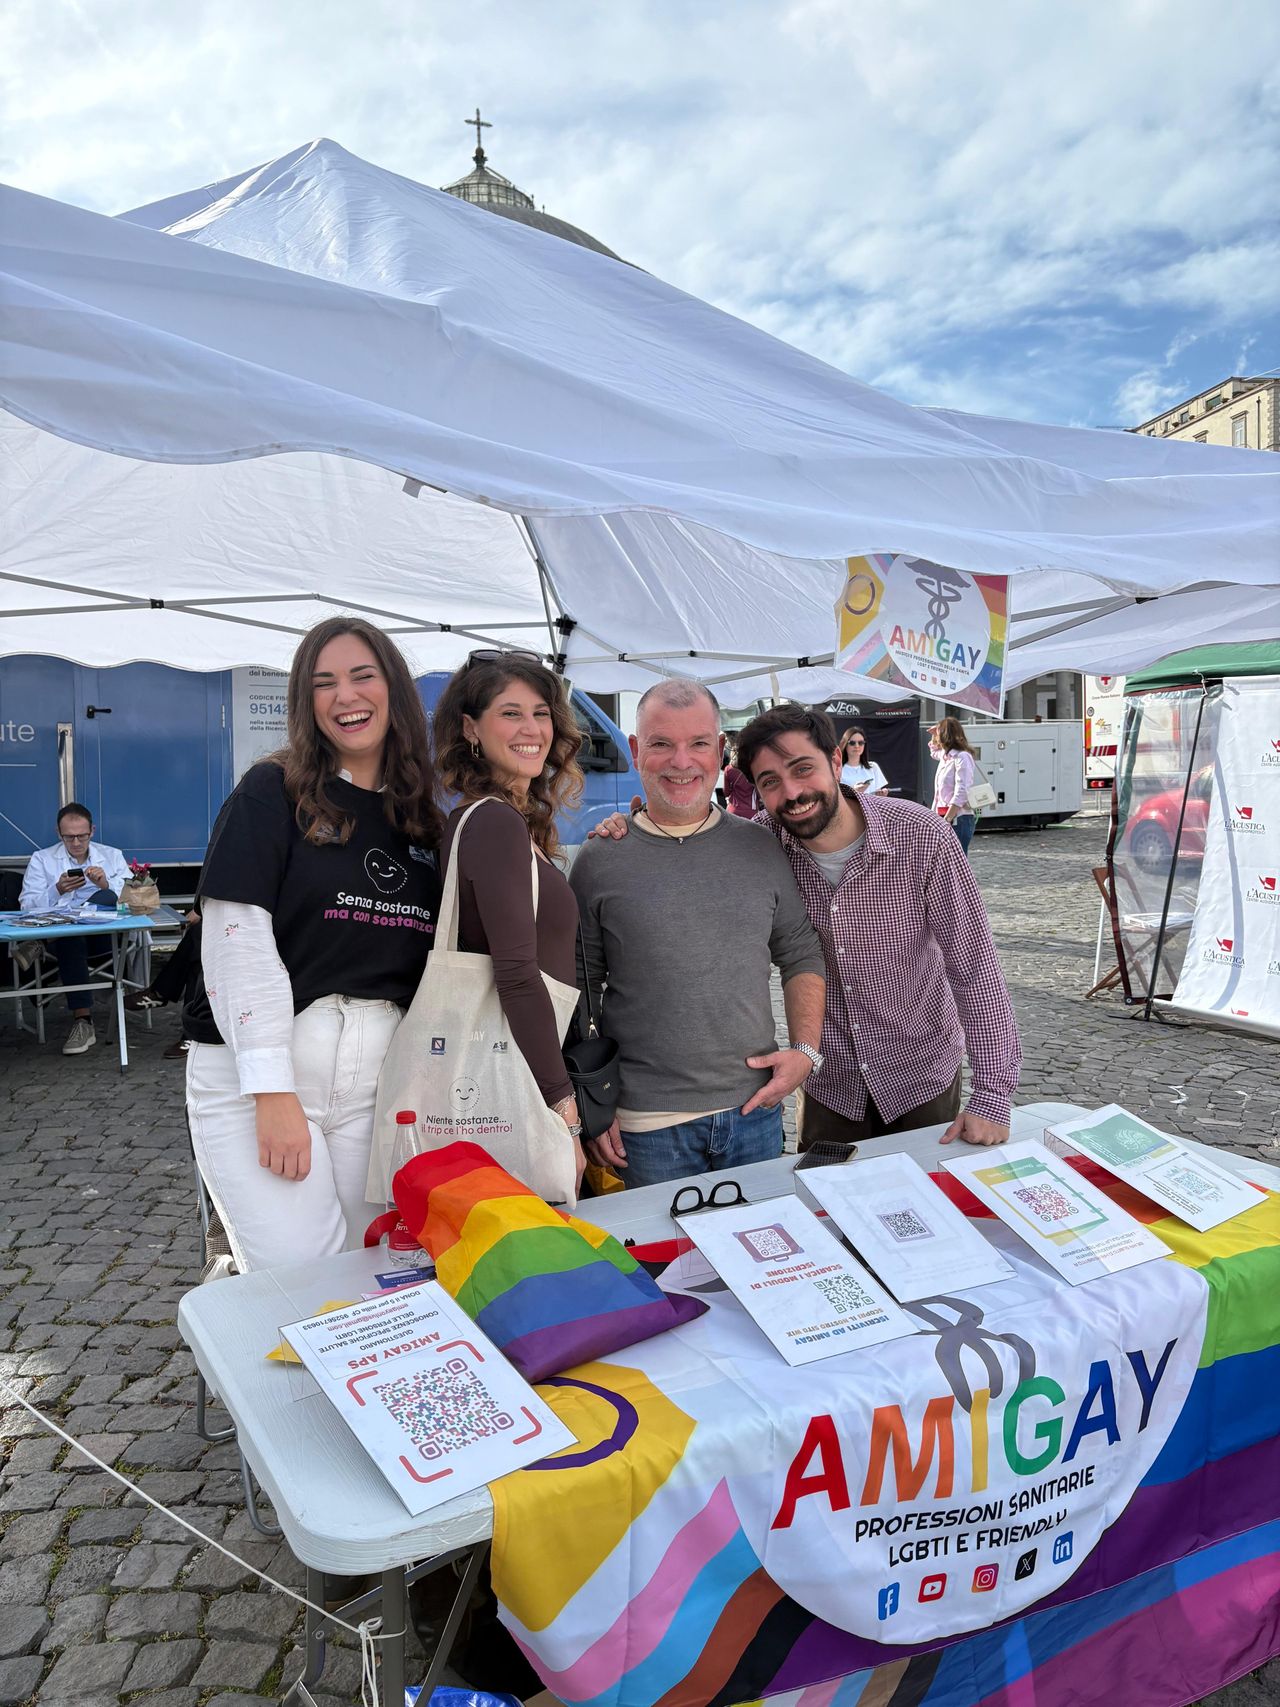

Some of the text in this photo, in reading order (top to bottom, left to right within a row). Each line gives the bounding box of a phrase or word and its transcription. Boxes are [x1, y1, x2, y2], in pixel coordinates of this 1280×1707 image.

[889, 624, 981, 670] AMIGAY
[336, 892, 431, 920] Senza sostanze
[324, 908, 350, 920] ma
[352, 910, 371, 923] con
[425, 1114, 453, 1125] Niente
[421, 1124, 426, 1133] il
[427, 1124, 442, 1135] trip
[443, 1127, 454, 1135] ce
[476, 1123, 513, 1134] dentro!
[765, 1261, 816, 1278] ISCRIZIONE
[804, 1264, 843, 1278] SCARICA
[750, 1282, 763, 1290] DI
[762, 1275, 799, 1288] MODULI
[400, 1290, 421, 1300] DONA
[378, 1299, 390, 1308] per
[391, 1310, 415, 1322] DELLE
[819, 1317, 850, 1330] NOSTRO
[317, 1310, 439, 1353] CONOSCENZE SPECIFICHE SALUTE
[357, 1319, 393, 1333] PERSONE
[794, 1315, 890, 1346] ISCRIVITI AD AMIGAY
[359, 1329, 414, 1351] QUESTIONARIO
[347, 1331, 441, 1370] AMIGAY APS
[770, 1337, 1178, 1530] AMIGAY
[855, 1465, 1096, 1543] PROFESSIONI SANITARIE
[889, 1508, 1068, 1568] LGBTI E FRIENDLY
